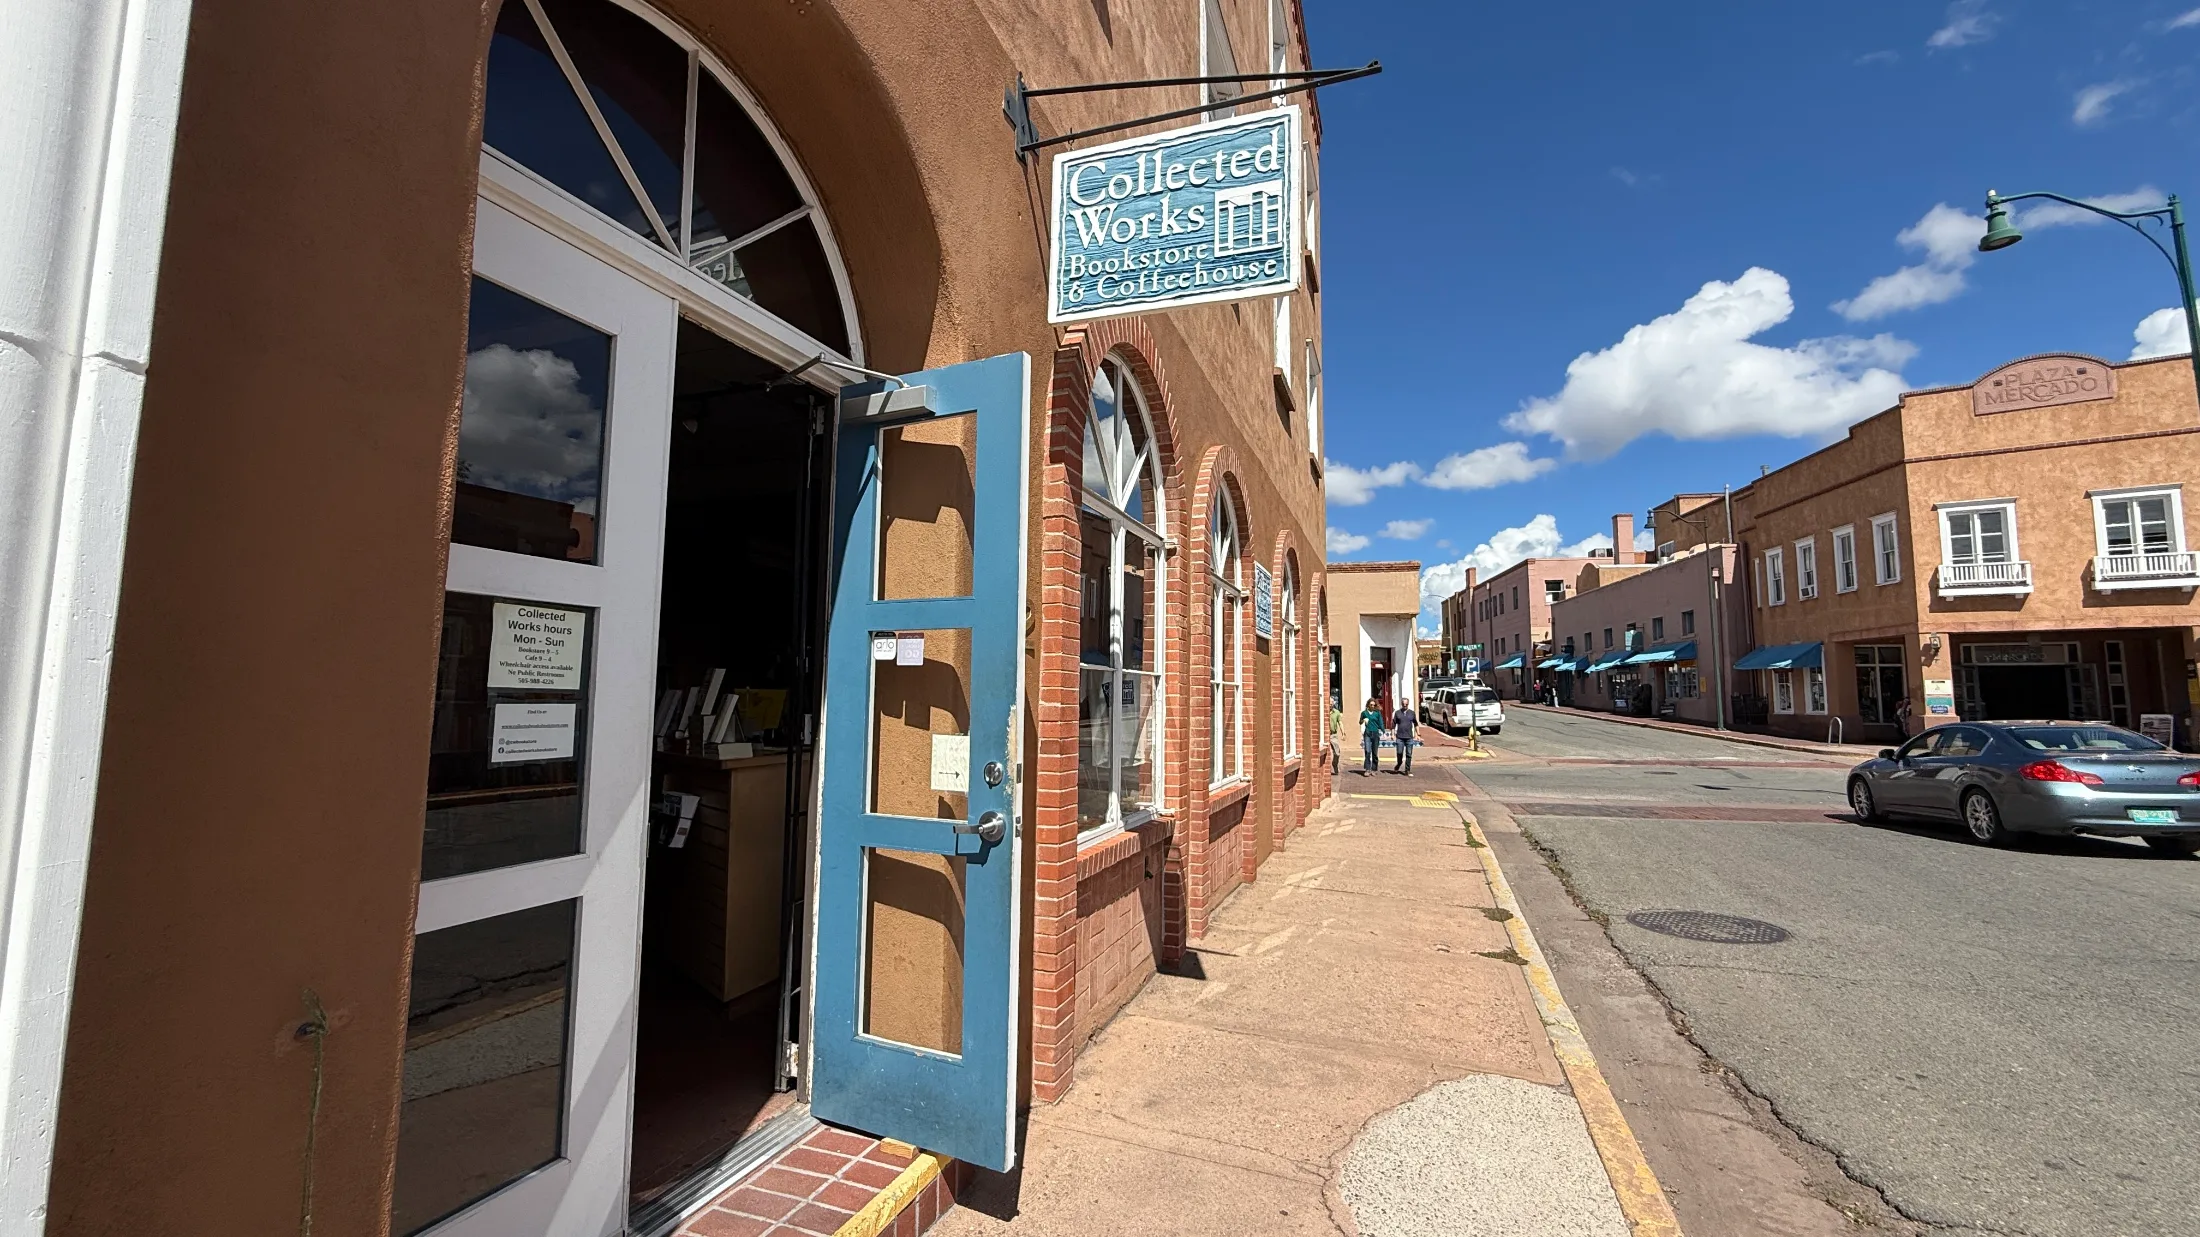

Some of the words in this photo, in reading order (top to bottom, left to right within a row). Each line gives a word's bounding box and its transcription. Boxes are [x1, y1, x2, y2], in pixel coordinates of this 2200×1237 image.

[1069, 126, 1281, 206] Collected
[1068, 192, 1206, 250] Works
[1069, 242, 1208, 279] Bookstore
[1068, 281, 1085, 303] &
[1097, 258, 1278, 299] Coffeehouse
[2003, 365, 2076, 387] PLAZA
[1984, 377, 2098, 405] MERCADO
[518, 608, 566, 621] Collected
[508, 620, 541, 632] Works
[543, 623, 572, 635] hours
[513, 633, 536, 645] Mon
[545, 636, 565, 647] Sun
[876, 639, 894, 649] arlo
[518, 646, 546, 655] Bookstore
[499, 660, 532, 669] Wheelchair
[550, 664, 574, 672] available
[1466, 659, 1477, 672] P
[517, 669, 536, 677] Public
